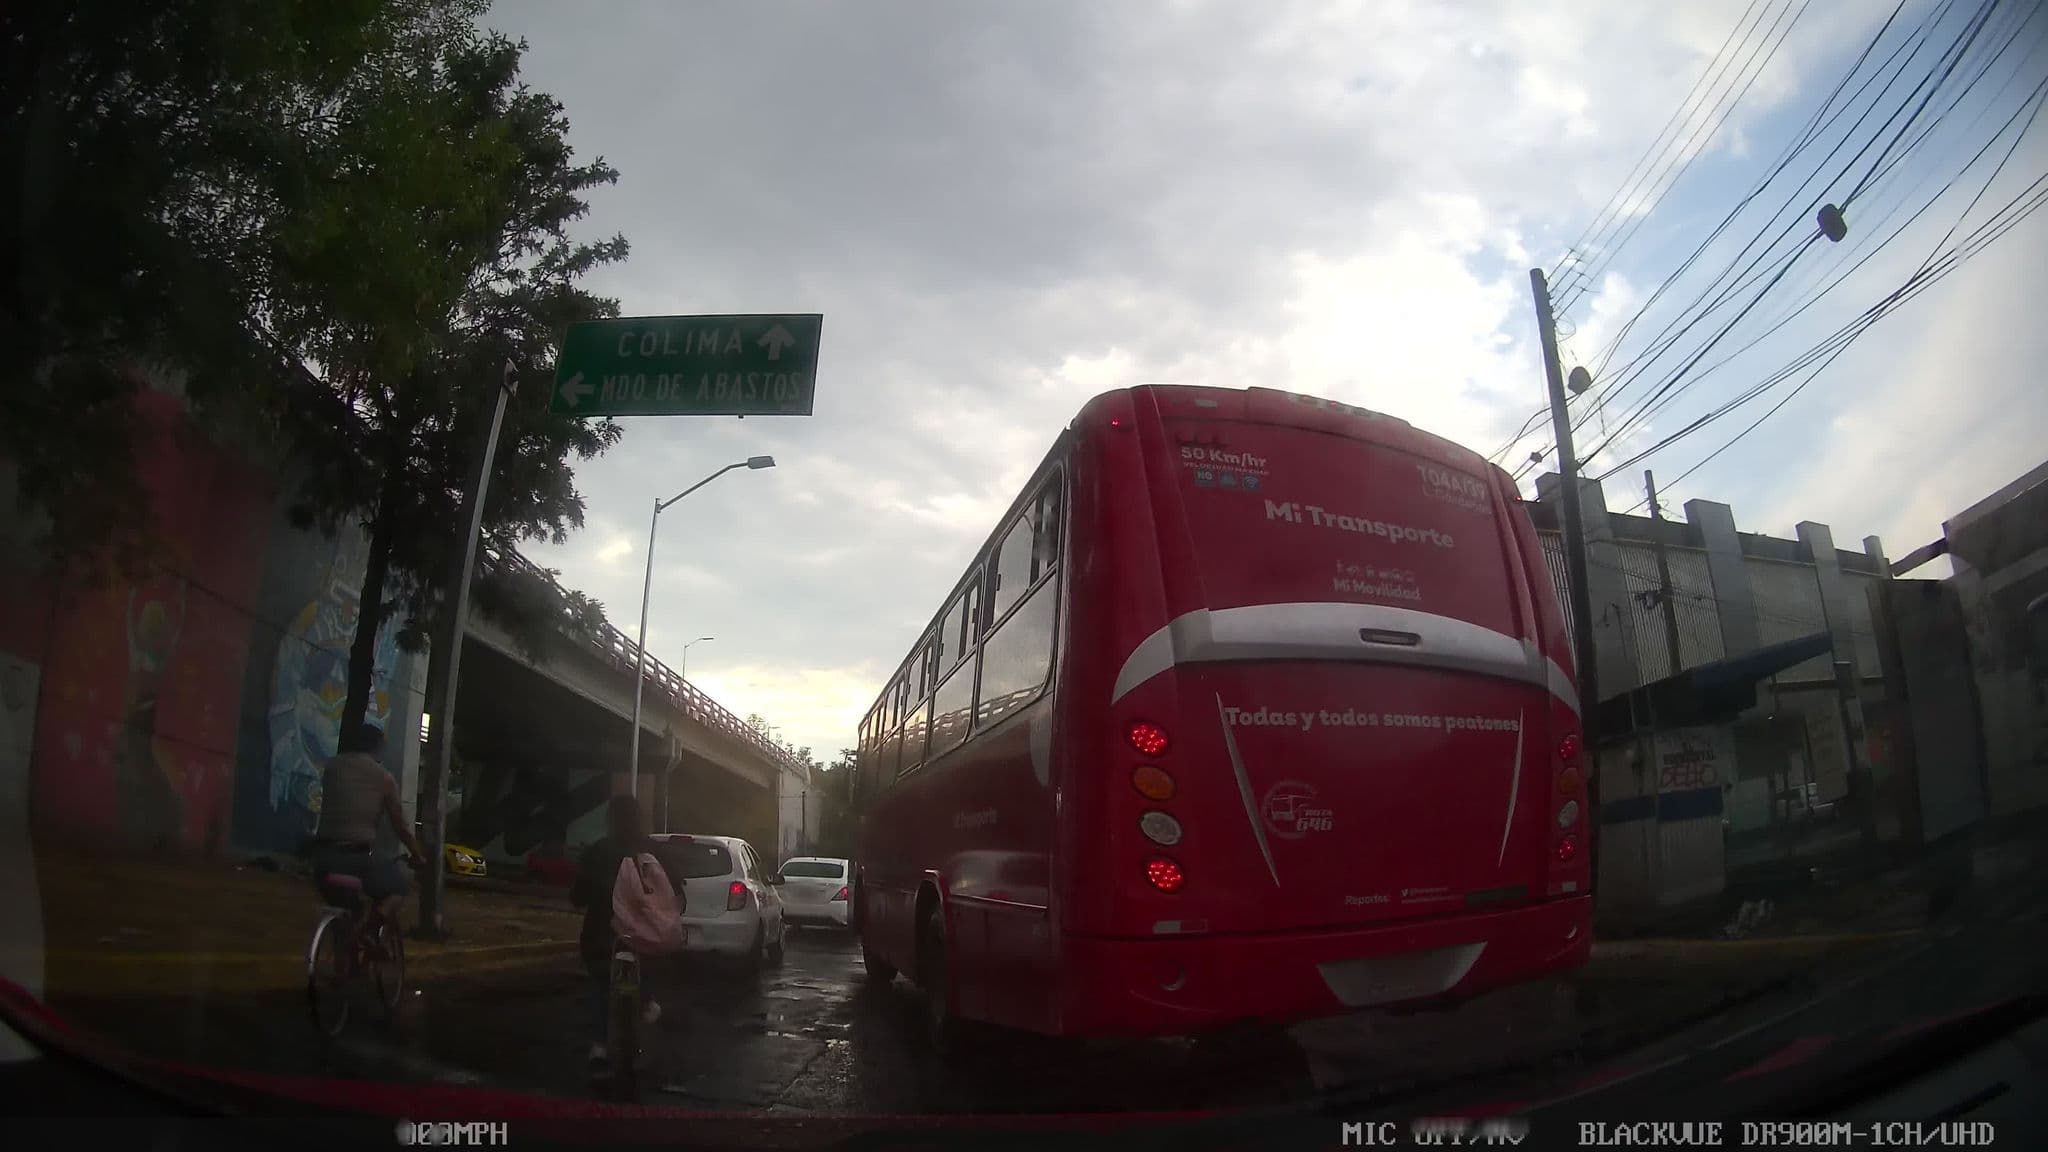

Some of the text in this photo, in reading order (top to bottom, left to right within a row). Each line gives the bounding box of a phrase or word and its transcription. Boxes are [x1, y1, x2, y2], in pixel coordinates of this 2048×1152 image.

[618, 328, 743, 358] COLIMA
[656, 373, 683, 402] DE
[696, 371, 801, 402] ABASTOS
[1181, 446, 1268, 470] 50 Km/hr
[1264, 499, 1455, 549] Mi Transporte
[1333, 577, 1422, 601] Mi Movilidad
[1225, 706, 1519, 733] Todas y todos somos peatones
[1296, 816, 1333, 832] 646
